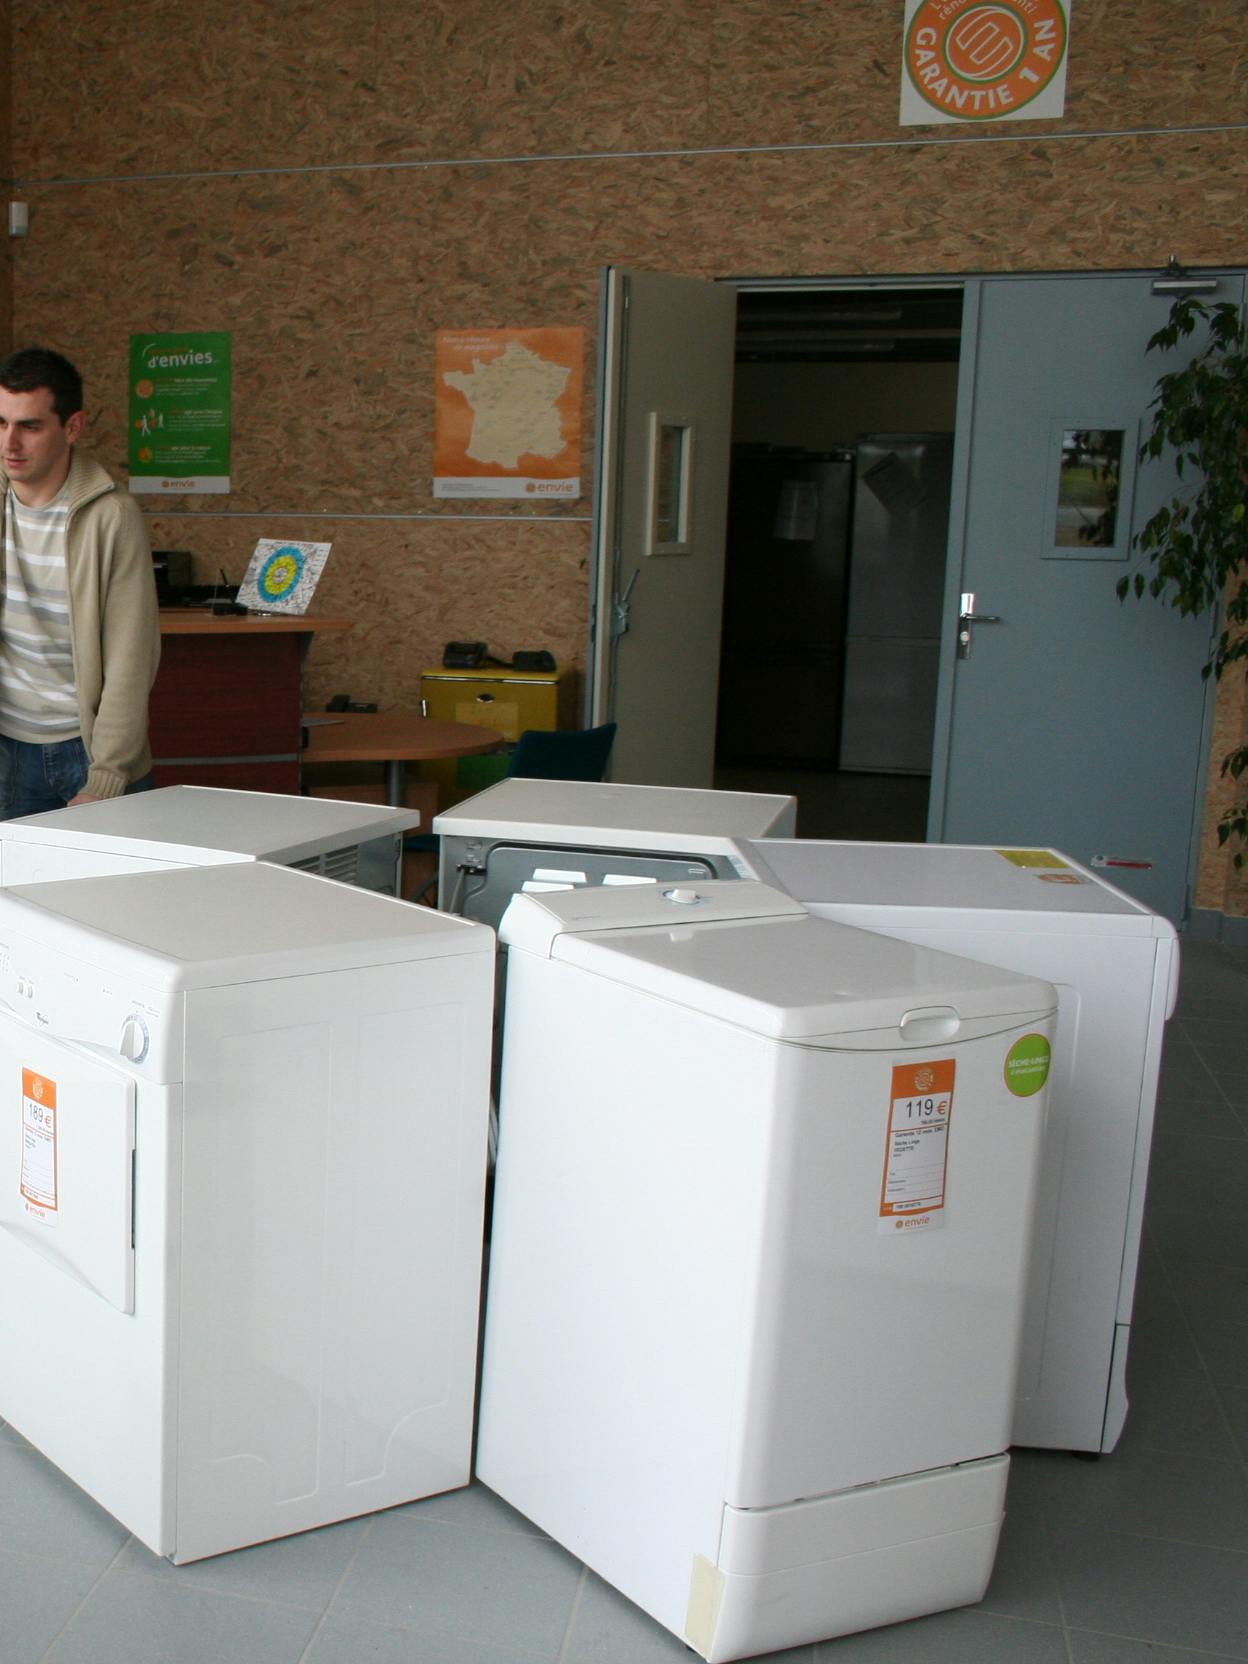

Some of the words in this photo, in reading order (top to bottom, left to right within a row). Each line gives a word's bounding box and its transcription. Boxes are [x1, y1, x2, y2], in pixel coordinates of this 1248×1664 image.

[915, 27, 1014, 110] GARANTIE
[1019, 66, 1040, 83] 1
[1032, 18, 1056, 62] AN
[148, 349, 213, 369] d'envies
[537, 481, 574, 494] envie
[28, 1103, 44, 1123] 189
[44, 1115, 52, 1128] €
[906, 1098, 934, 1118] 119
[937, 1100, 948, 1115] €
[904, 1215, 930, 1227] envie
